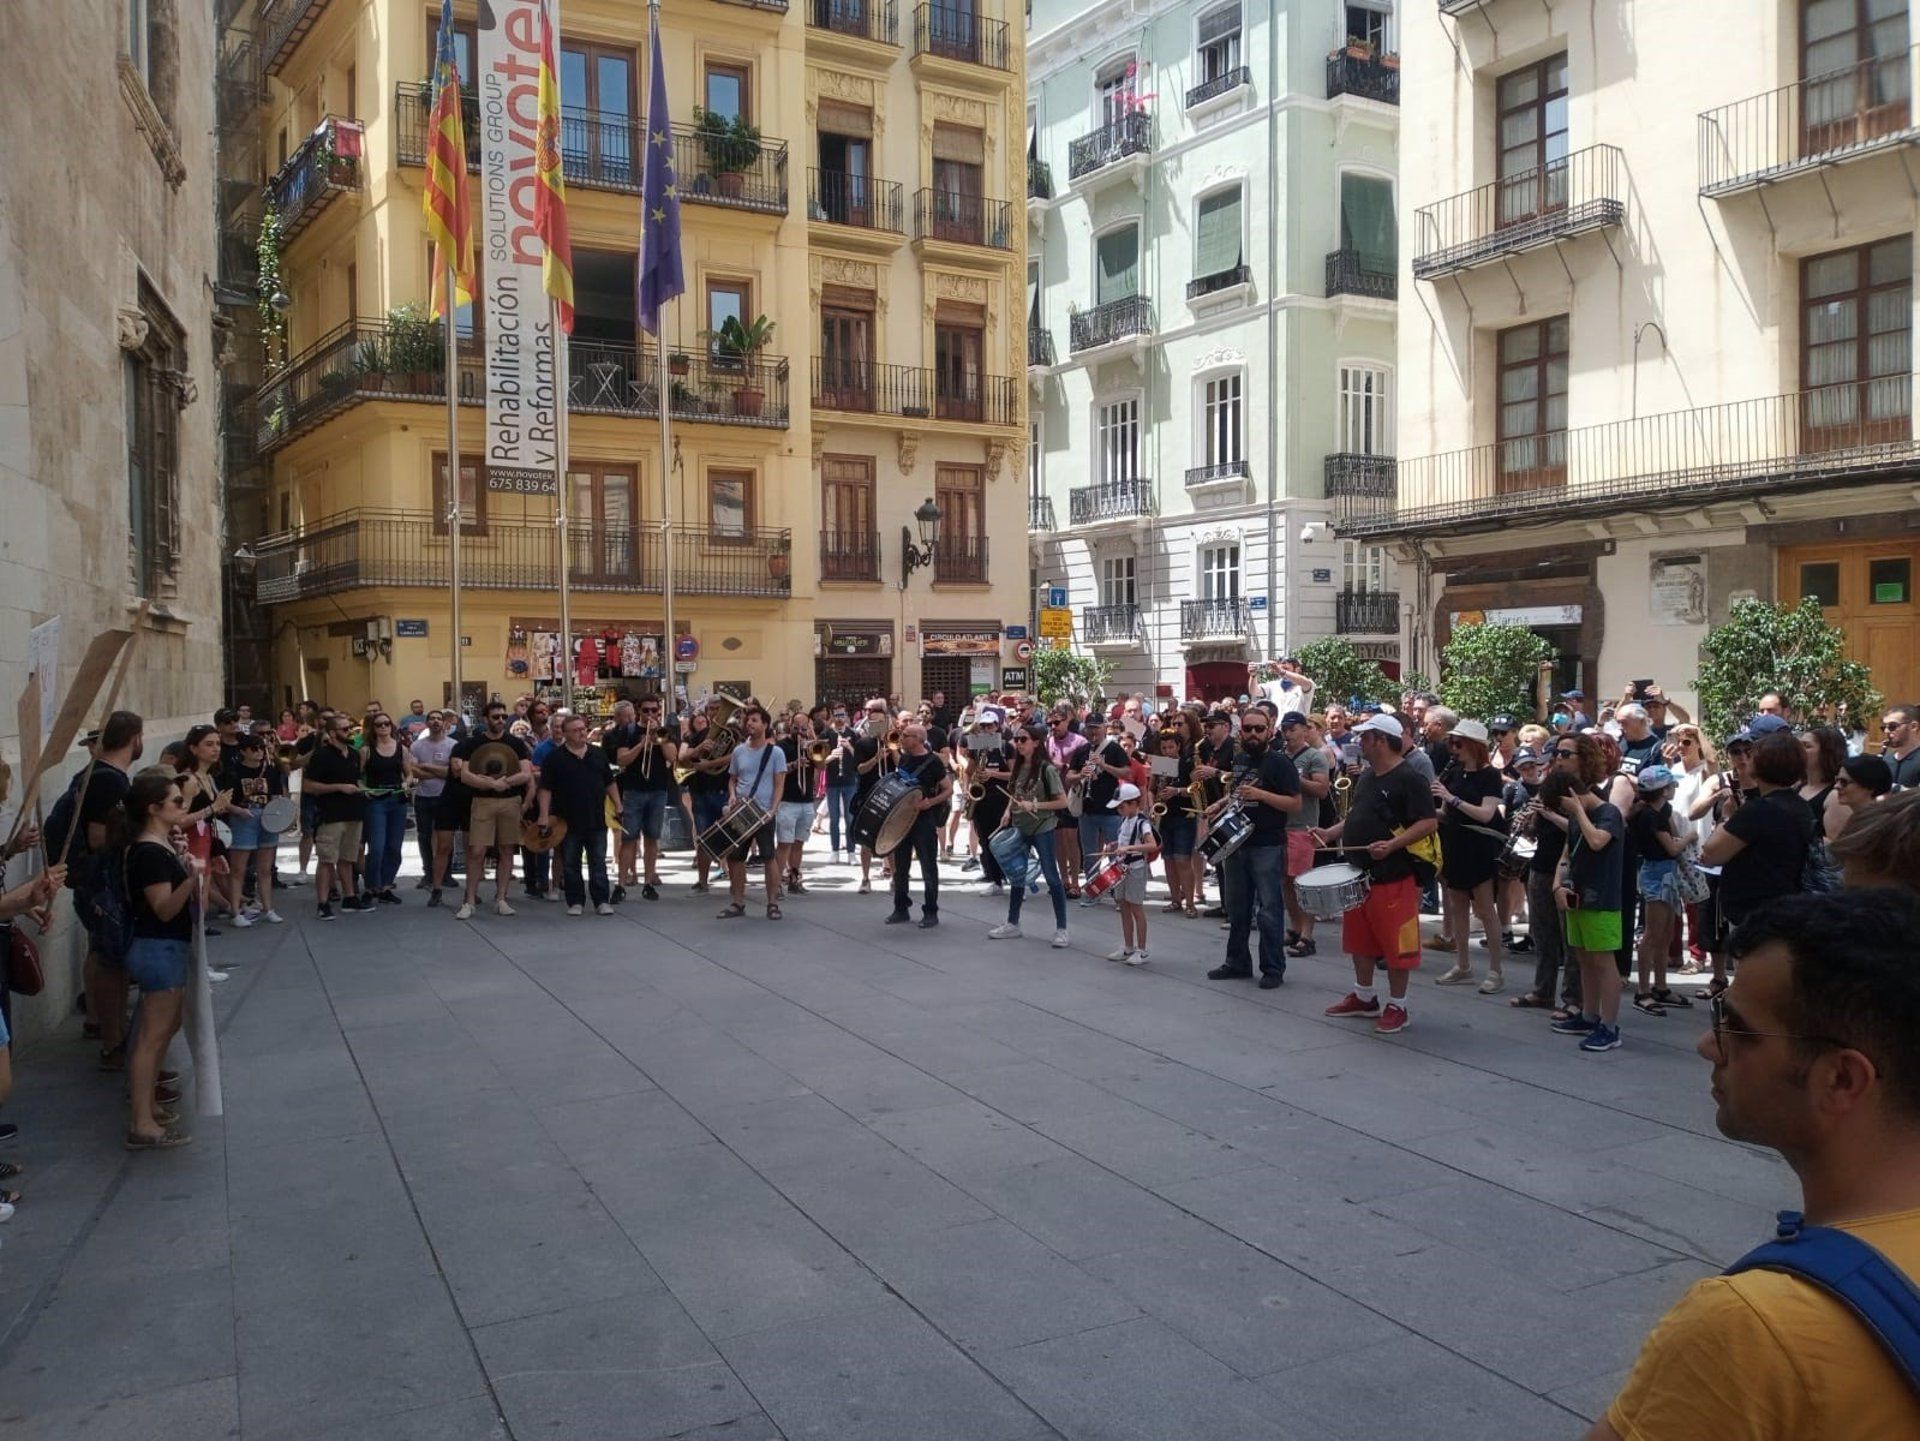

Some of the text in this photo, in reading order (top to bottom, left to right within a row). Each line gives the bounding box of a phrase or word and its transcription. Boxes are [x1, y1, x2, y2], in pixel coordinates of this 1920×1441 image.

[485, 73, 507, 262] SOLUTIONS GROUP
[489, 276, 521, 461] Rehabilitación
[526, 322, 556, 443] Reformas
[489, 478, 513, 489] 675
[515, 480, 539, 491] 839
[961, 633, 993, 642] ATLANTE
[1004, 671, 1025, 681] ATM
